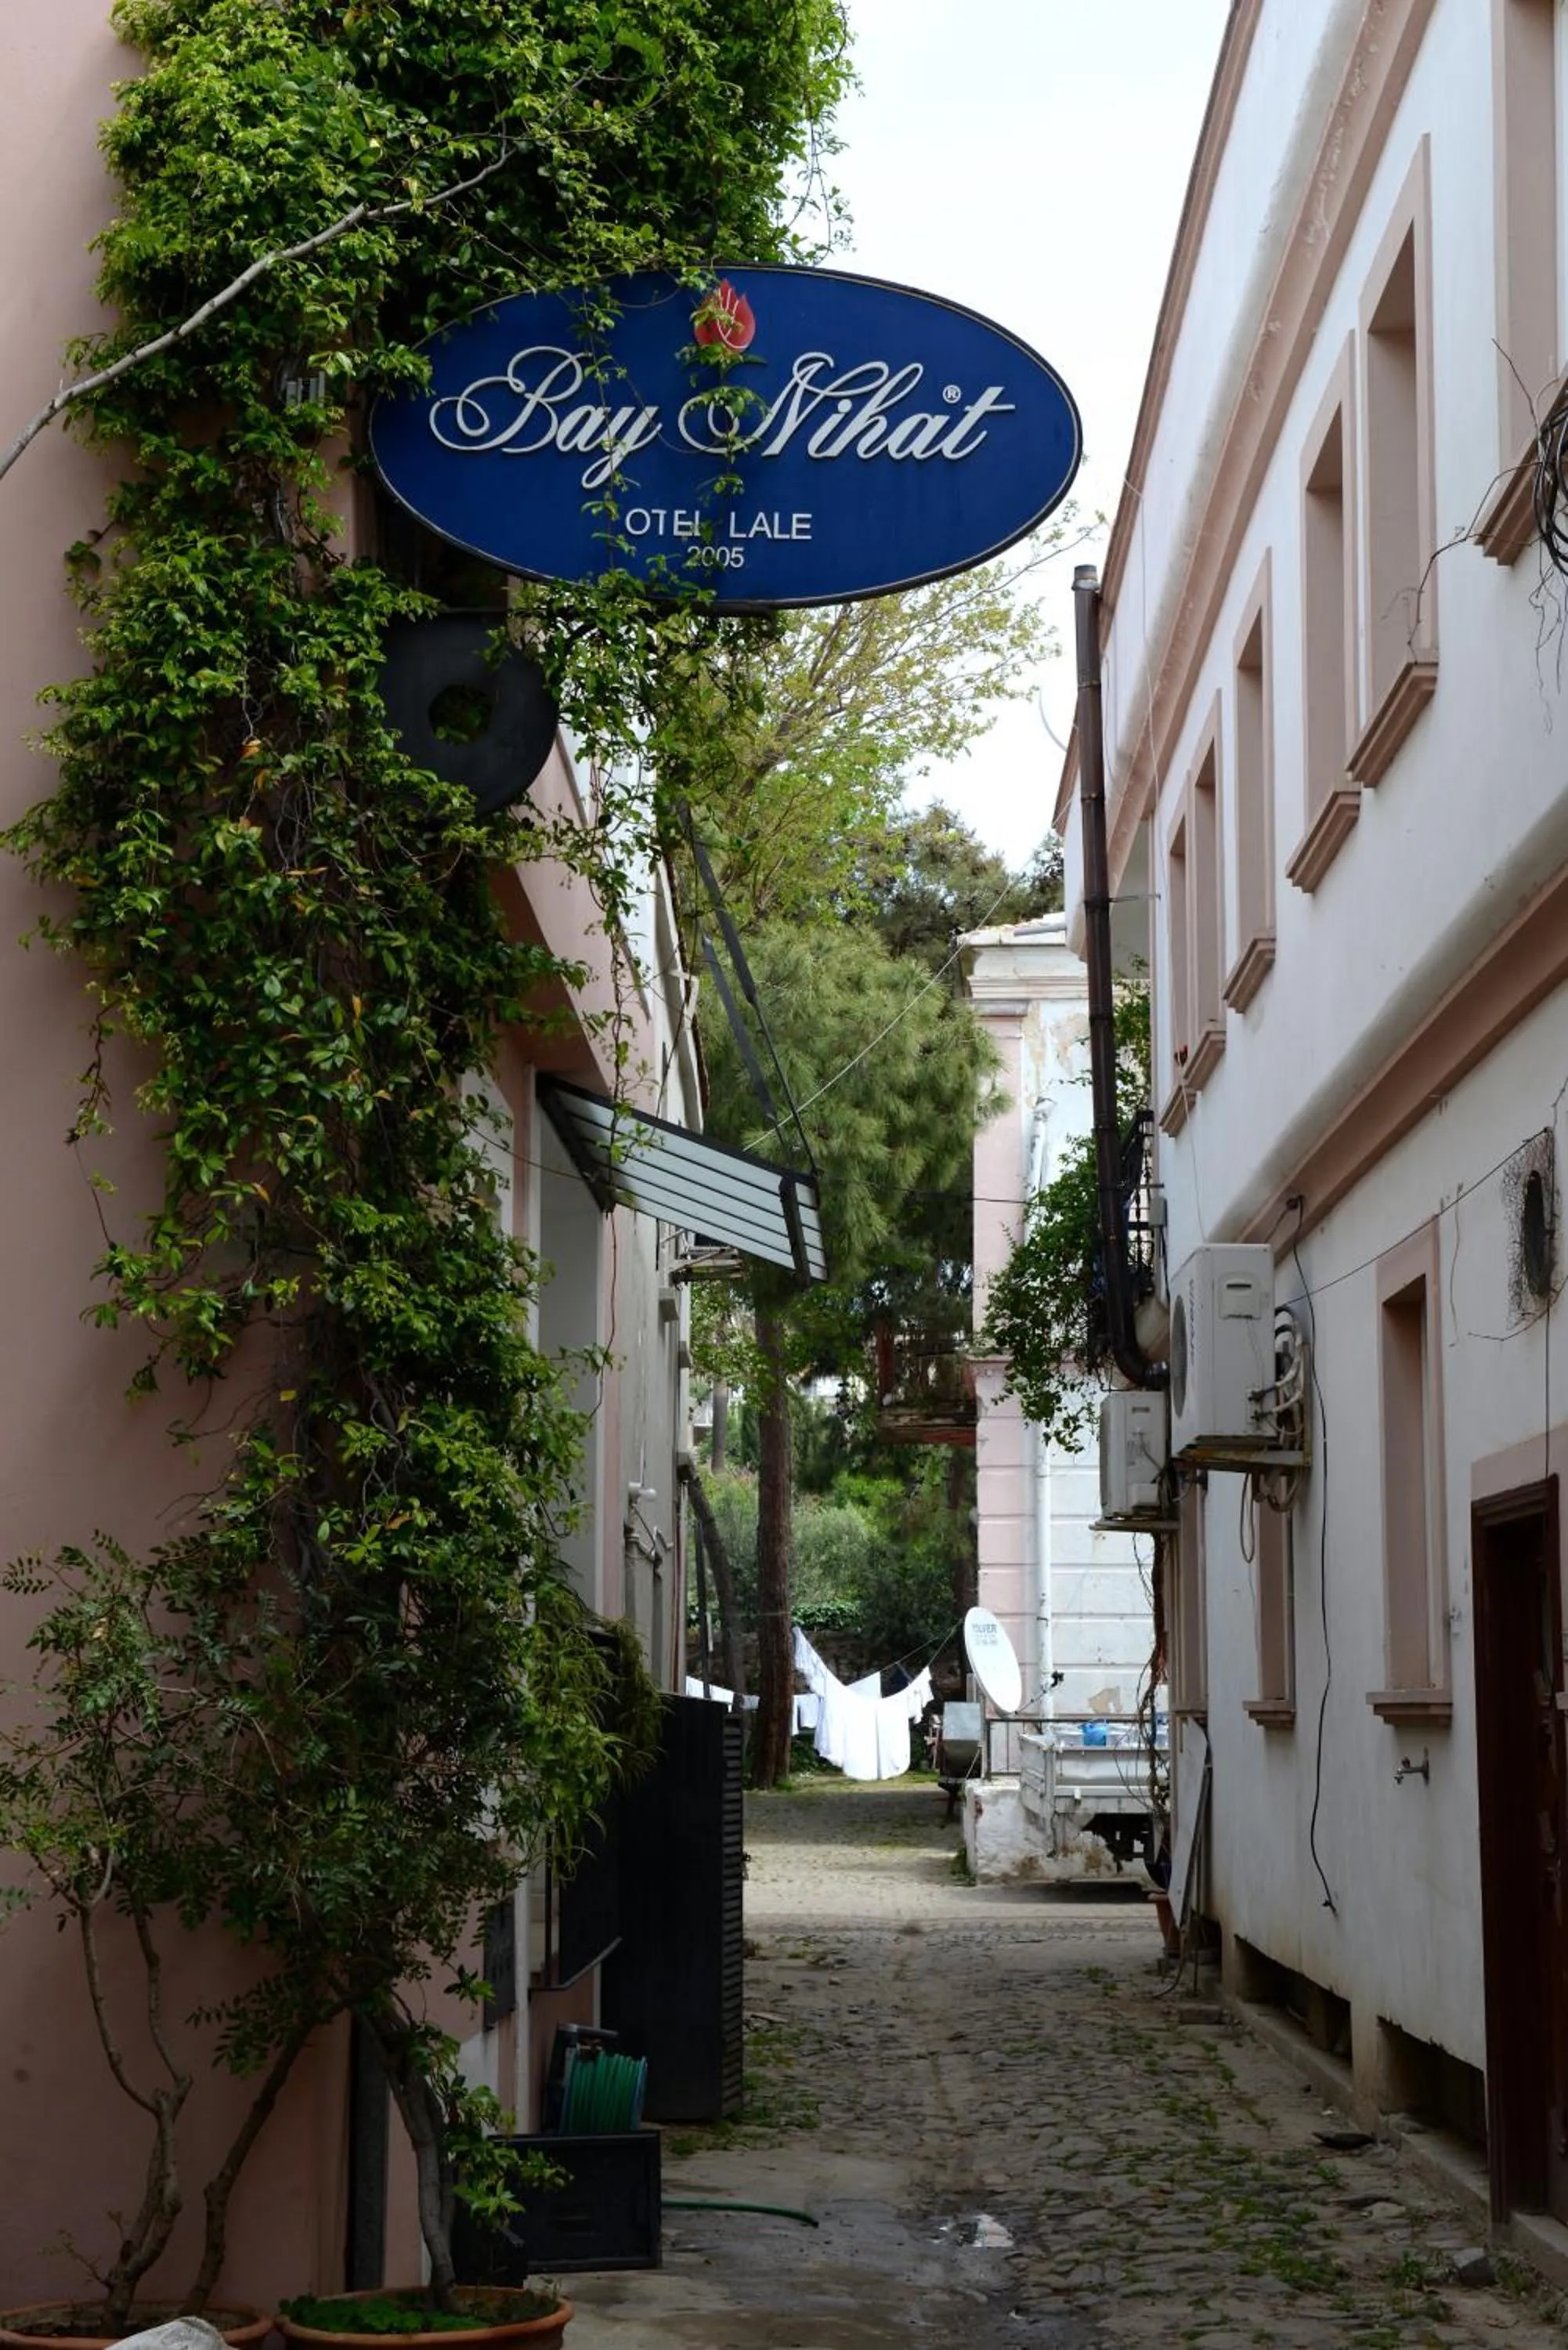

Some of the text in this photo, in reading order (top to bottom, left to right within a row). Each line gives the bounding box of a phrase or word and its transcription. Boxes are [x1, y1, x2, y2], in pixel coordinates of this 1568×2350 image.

[429, 345, 1016, 489] Bay Nihat
[625, 508, 812, 540] OTEL LALE
[686, 546, 744, 568] 2005
